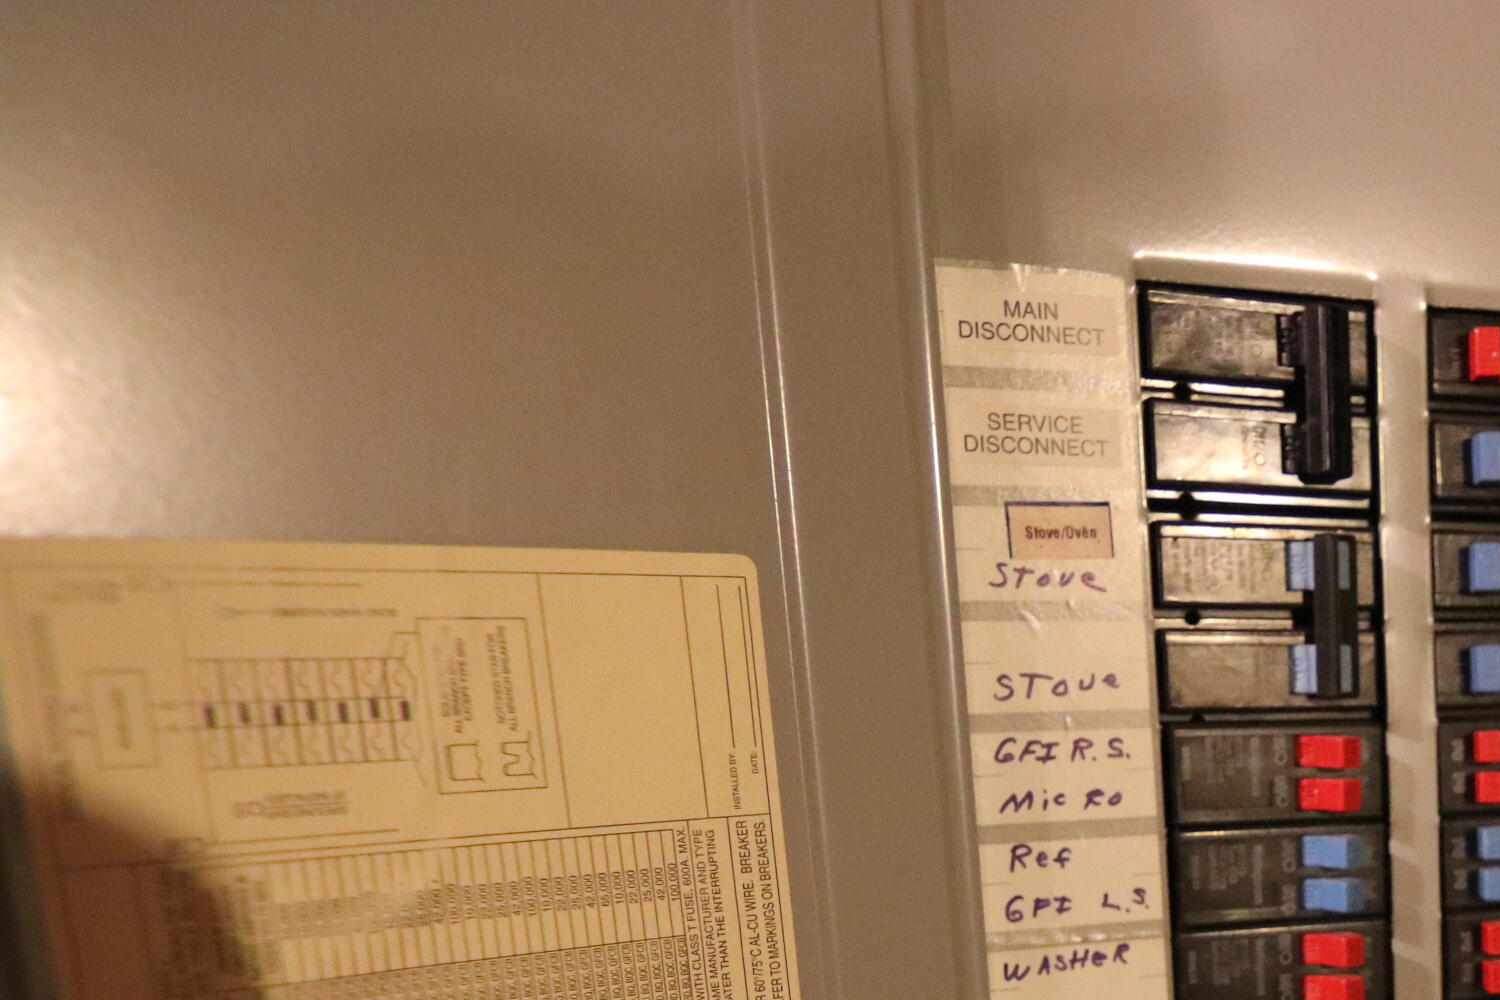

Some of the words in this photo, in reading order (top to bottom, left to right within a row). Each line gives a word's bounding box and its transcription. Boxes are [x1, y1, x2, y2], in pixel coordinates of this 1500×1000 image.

[1002, 299, 1059, 320] MAIN
[958, 319, 1104, 346] DISCONNECT
[987, 412, 1084, 434] SERVICE
[963, 433, 1109, 458] DISCONNECT
[1024, 525, 1097, 540] Stove/Oven
[993, 738, 1060, 765] GFI
[730, 765, 742, 810] INSTALLED
[676, 825, 688, 853] MAX.
[692, 828, 705, 858] TYPE
[736, 819, 752, 873] BREAKER
[705, 828, 723, 912] INTERRUPTING
[1010, 843, 1073, 872] Ref
[696, 860, 708, 885] AND
[761, 883, 773, 899] ON
[699, 886, 719, 978] MANUFACTURER
[715, 915, 726, 937] THE
[746, 913, 760, 947] AL-CU
[763, 901, 780, 959] MARKINGS
[689, 933, 702, 970] CLASS
[718, 939, 730, 969] THAN
[769, 960, 781, 975] TO
[693, 972, 706, 1000] WITH
